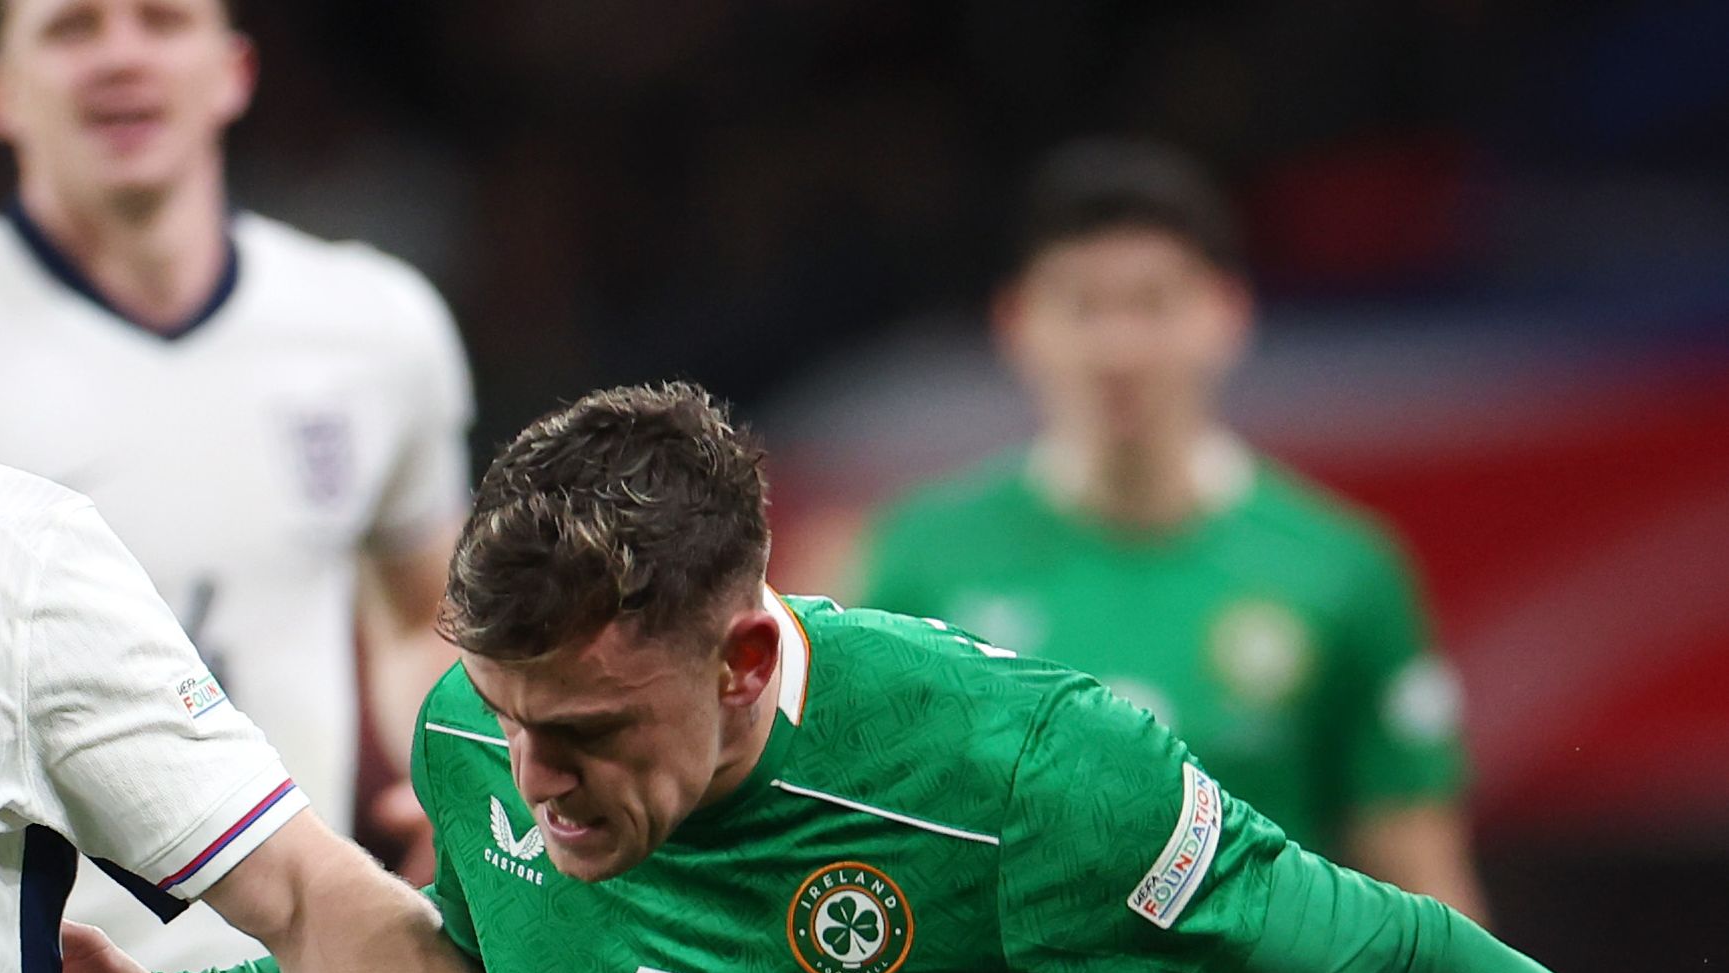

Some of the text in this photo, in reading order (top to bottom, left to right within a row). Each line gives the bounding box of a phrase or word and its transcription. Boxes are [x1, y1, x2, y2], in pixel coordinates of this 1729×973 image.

[176, 678, 196, 695] UEFA
[484, 848, 543, 885] CASTORE
[800, 870, 896, 909] IRELAND
[1134, 875, 1160, 907] UEFA
